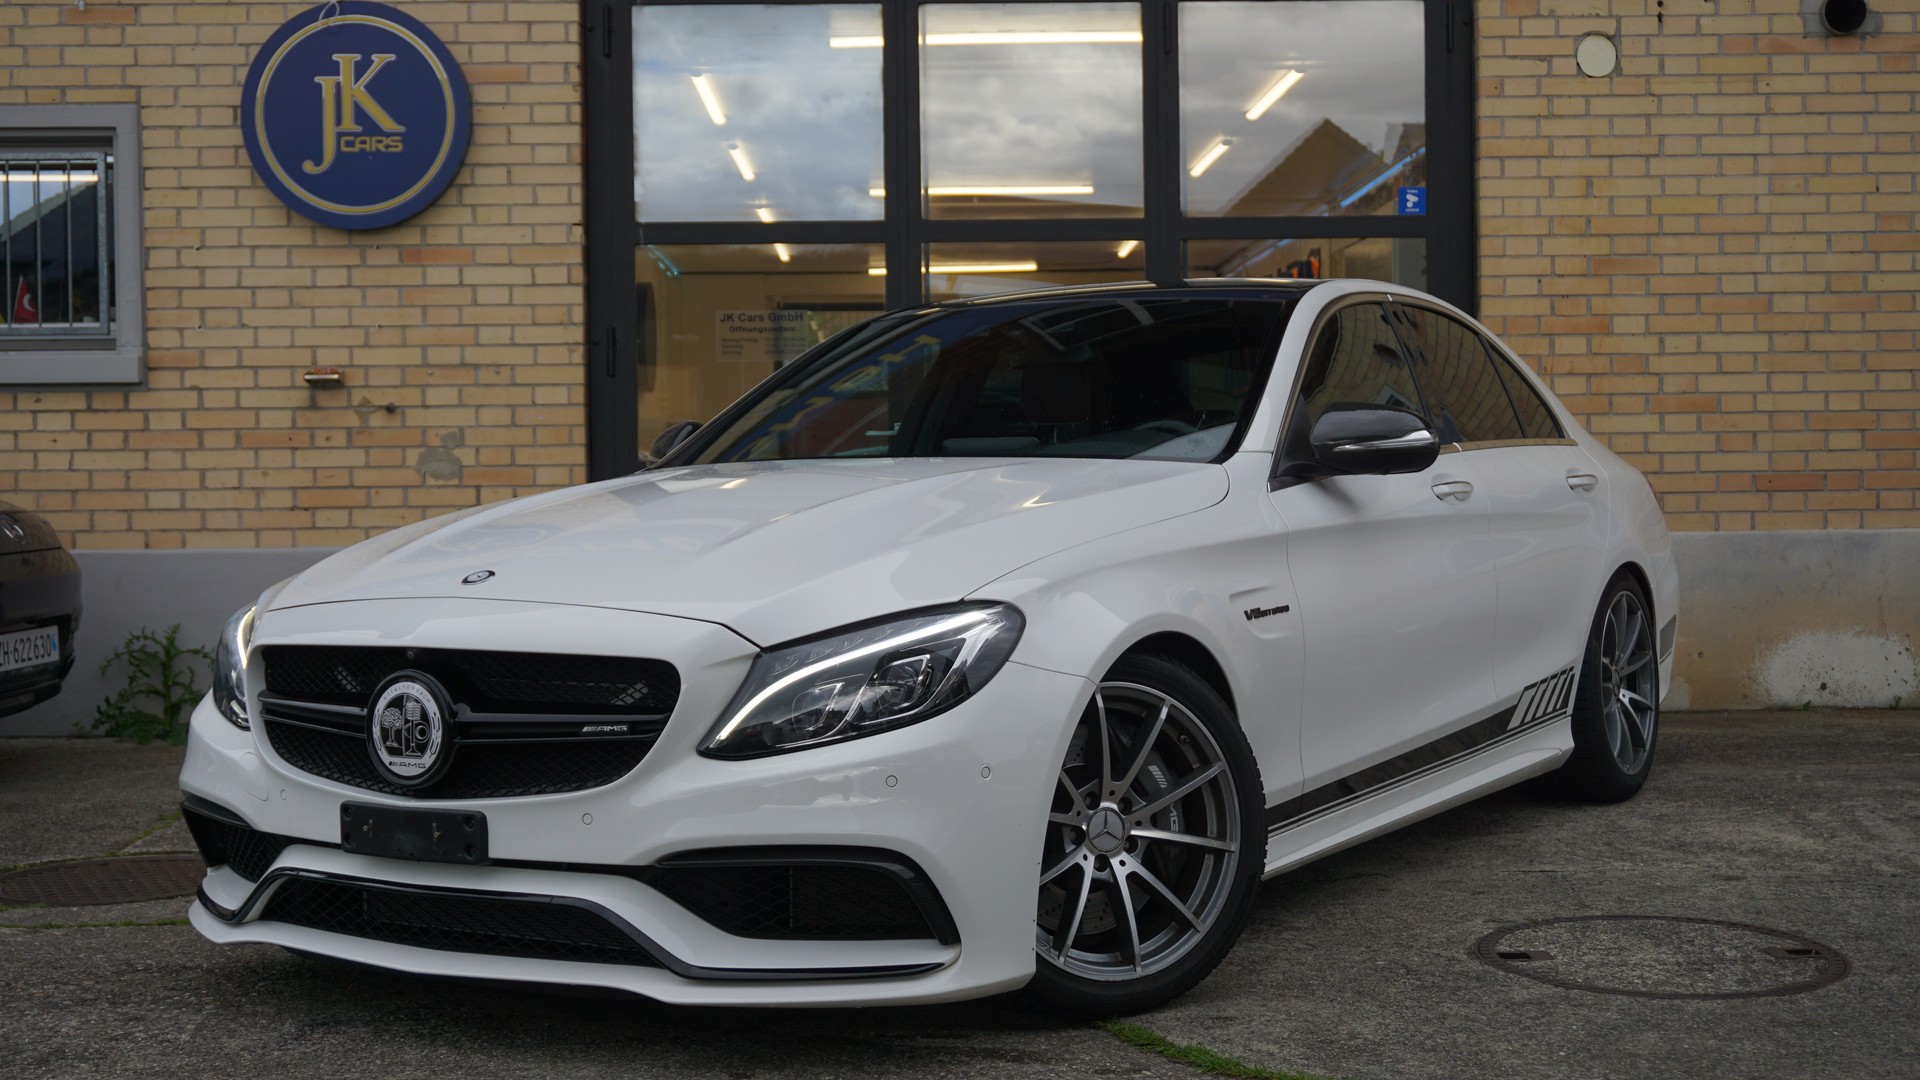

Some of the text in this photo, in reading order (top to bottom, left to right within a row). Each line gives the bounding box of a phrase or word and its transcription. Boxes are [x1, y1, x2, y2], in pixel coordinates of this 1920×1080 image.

[340, 136, 404, 153] CARS
[719, 312, 803, 322] JK Cars GmbH
